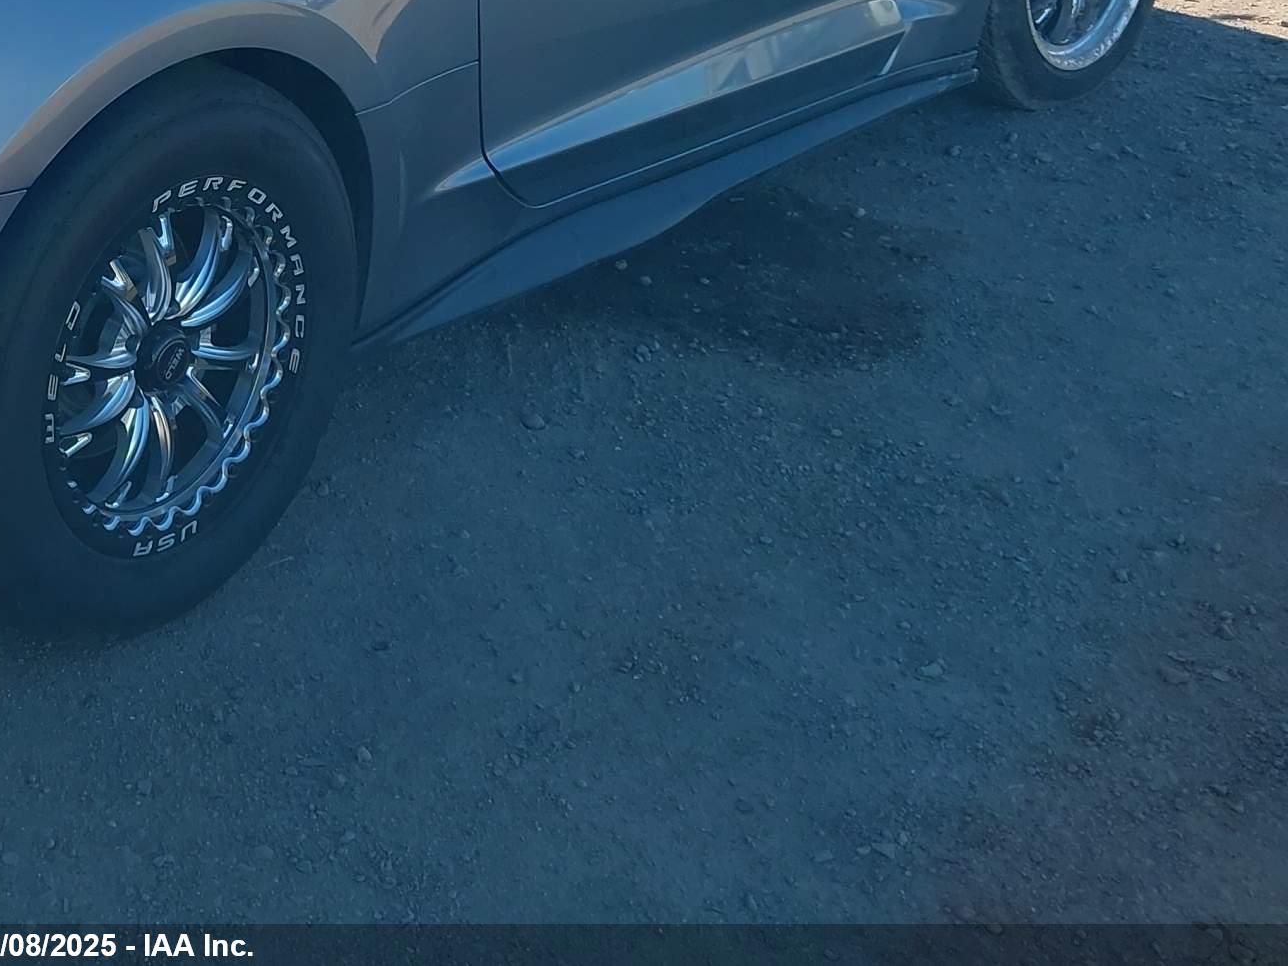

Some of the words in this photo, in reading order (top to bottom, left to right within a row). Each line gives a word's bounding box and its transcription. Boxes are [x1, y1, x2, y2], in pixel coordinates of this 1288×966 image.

[151, 175, 307, 374] PERFORMANCE
[44, 299, 81, 445] WELD
[165, 346, 185, 380] WELD
[132, 520, 199, 558] USA
